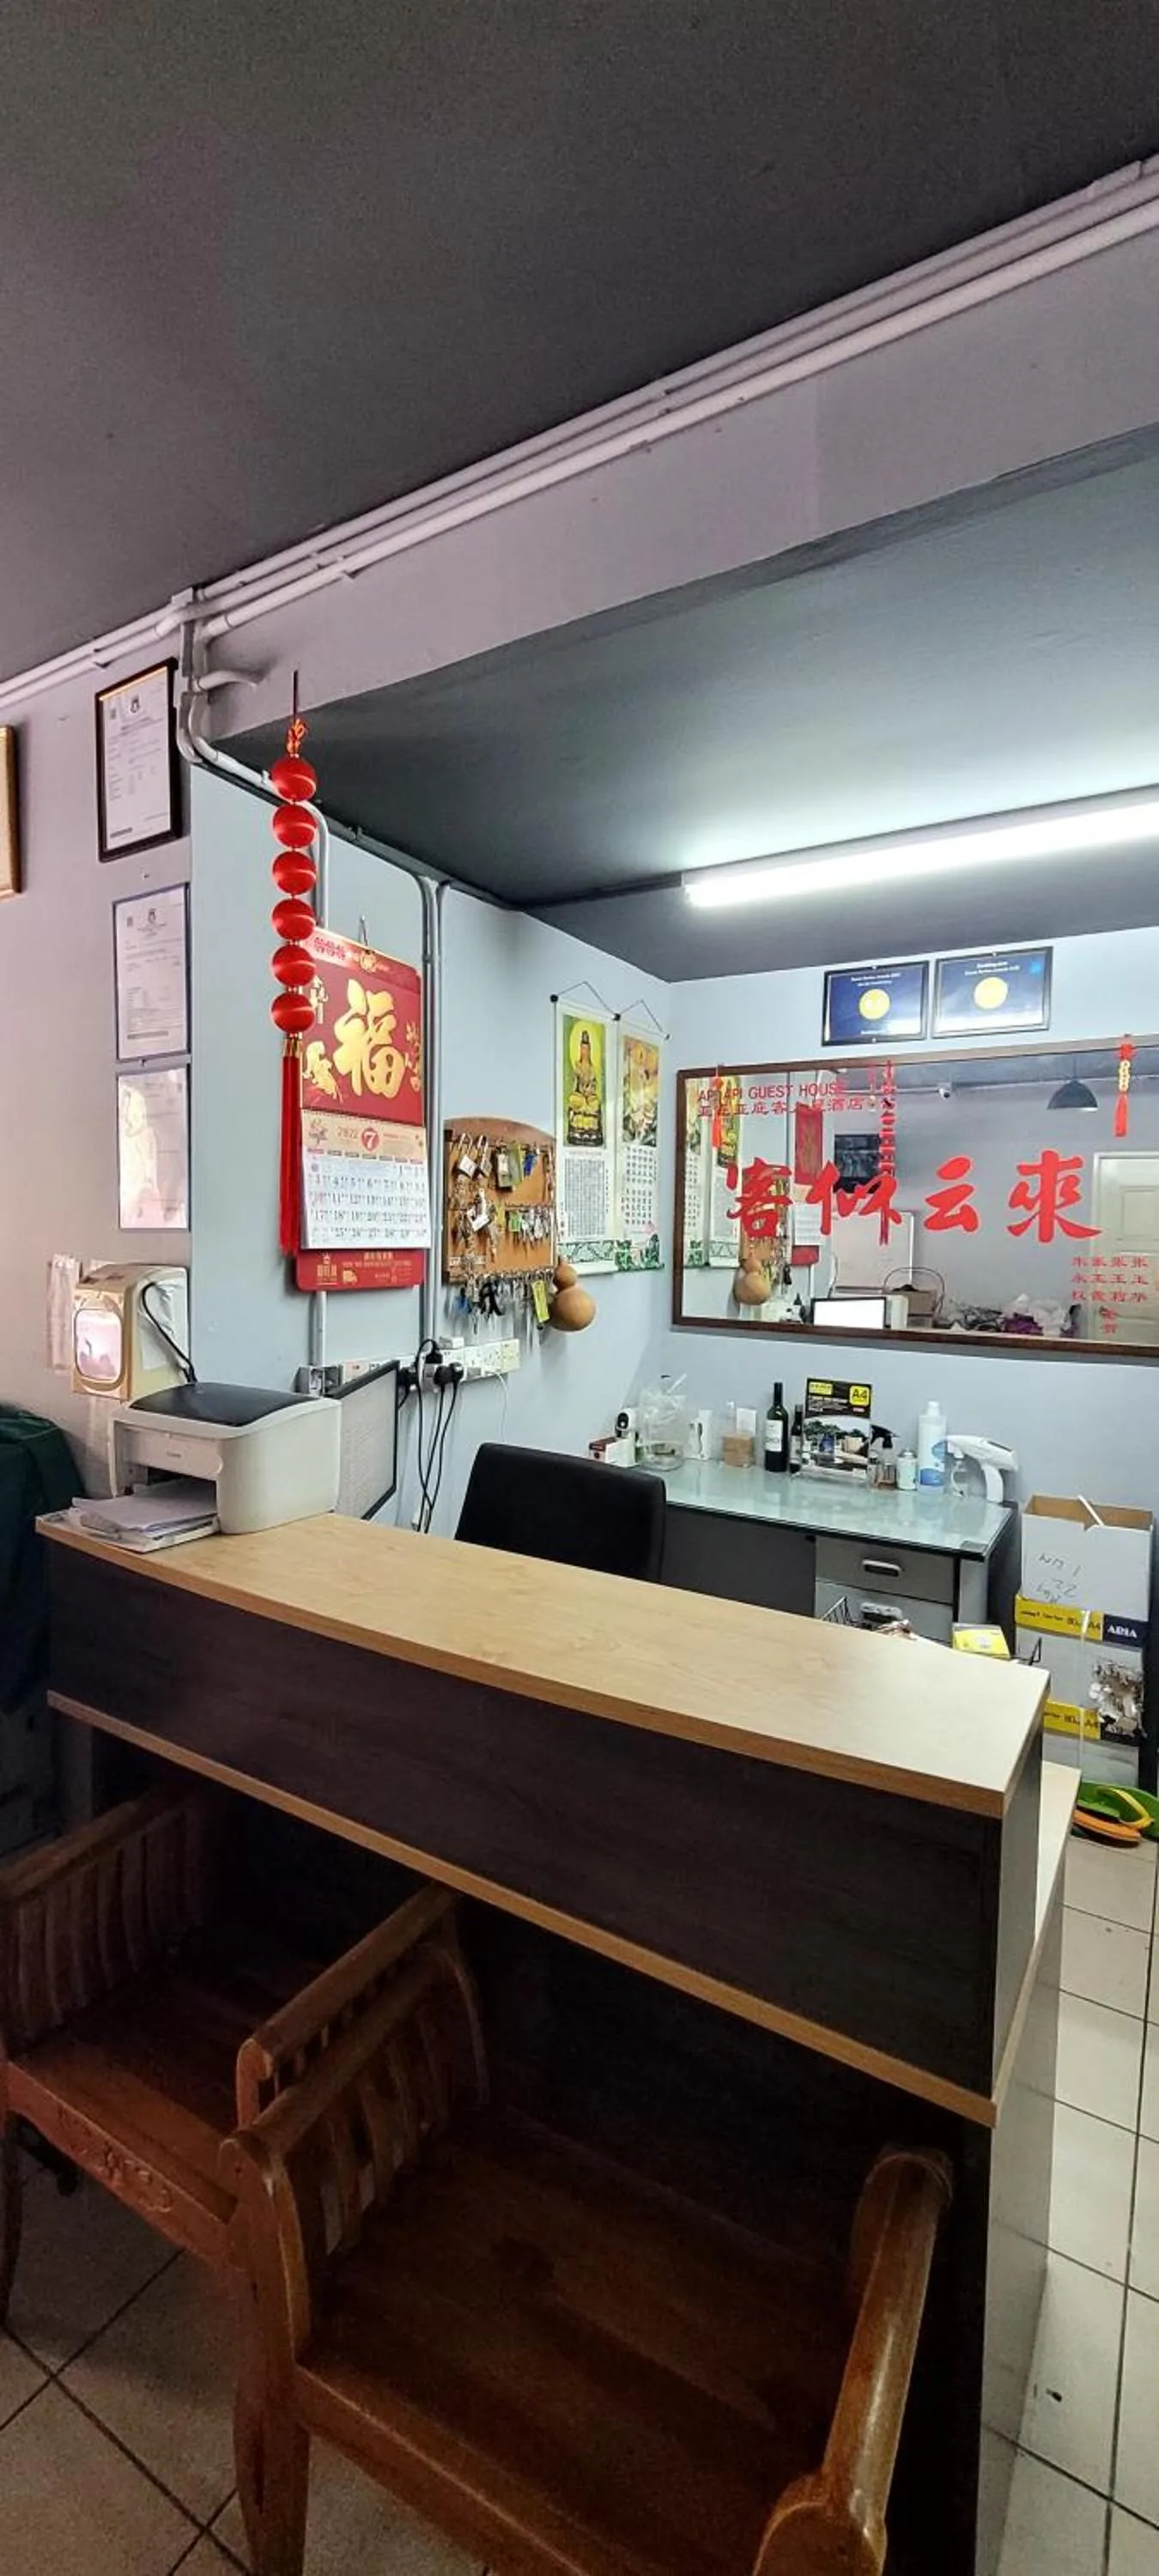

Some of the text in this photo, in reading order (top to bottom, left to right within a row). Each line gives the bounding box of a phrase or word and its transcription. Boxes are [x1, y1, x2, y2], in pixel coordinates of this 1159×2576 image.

[333, 978, 405, 1099] 福
[749, 1084, 793, 1100] GUEST
[363, 1131, 376, 1150] 7
[853, 1388, 867, 1399] A4
[1107, 1625, 1138, 1639] ARIA
